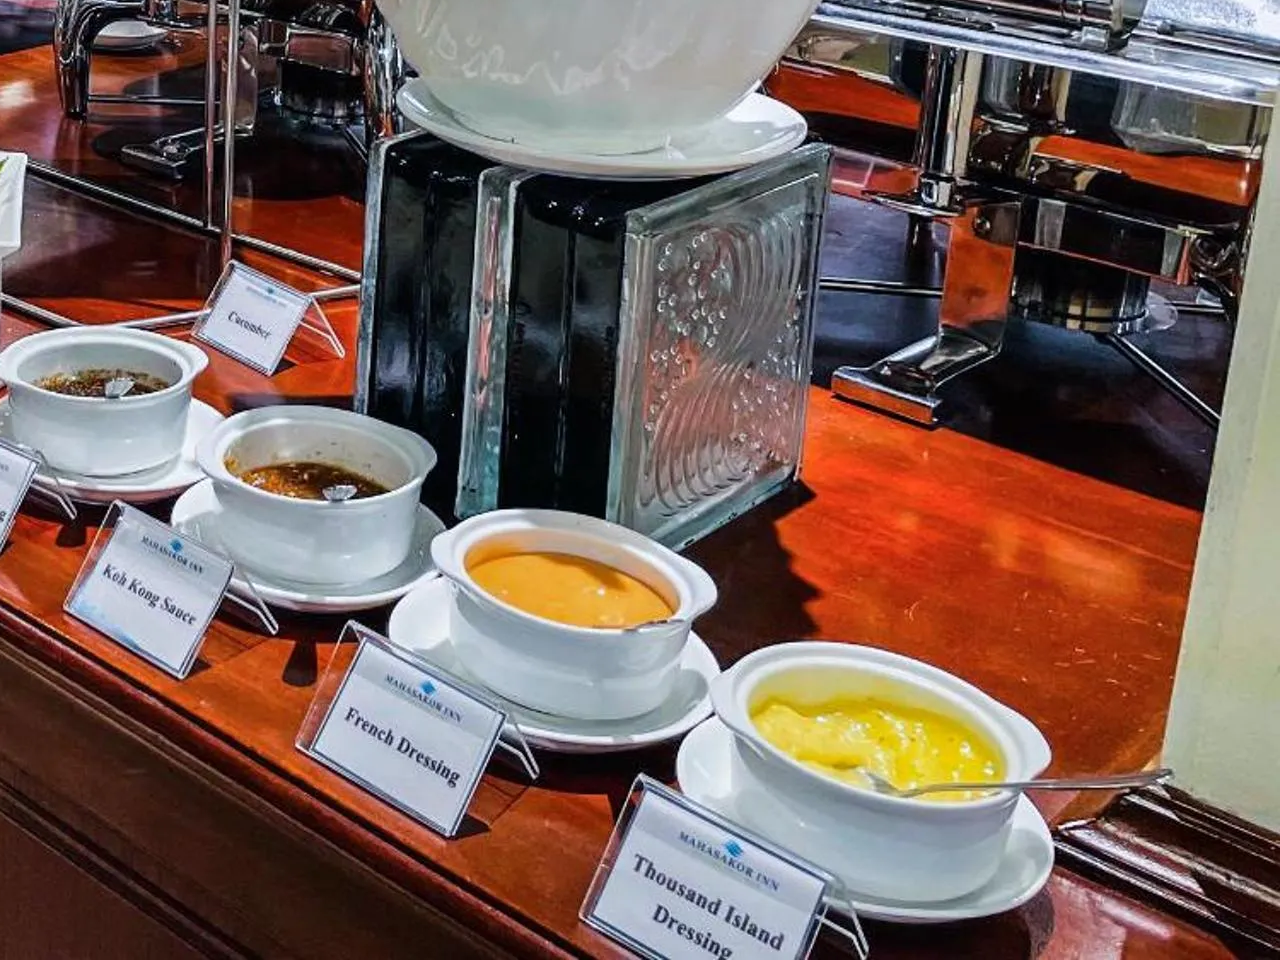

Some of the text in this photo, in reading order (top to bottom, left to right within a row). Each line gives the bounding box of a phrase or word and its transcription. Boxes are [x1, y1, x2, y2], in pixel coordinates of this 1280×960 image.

[103, 563, 198, 626] Koh Kong Sauce
[343, 707, 461, 788] French Dressing
[679, 831, 780, 892] MAHASAKOR INN
[633, 854, 785, 952] Thousand Island
[652, 903, 733, 960] Dressing
